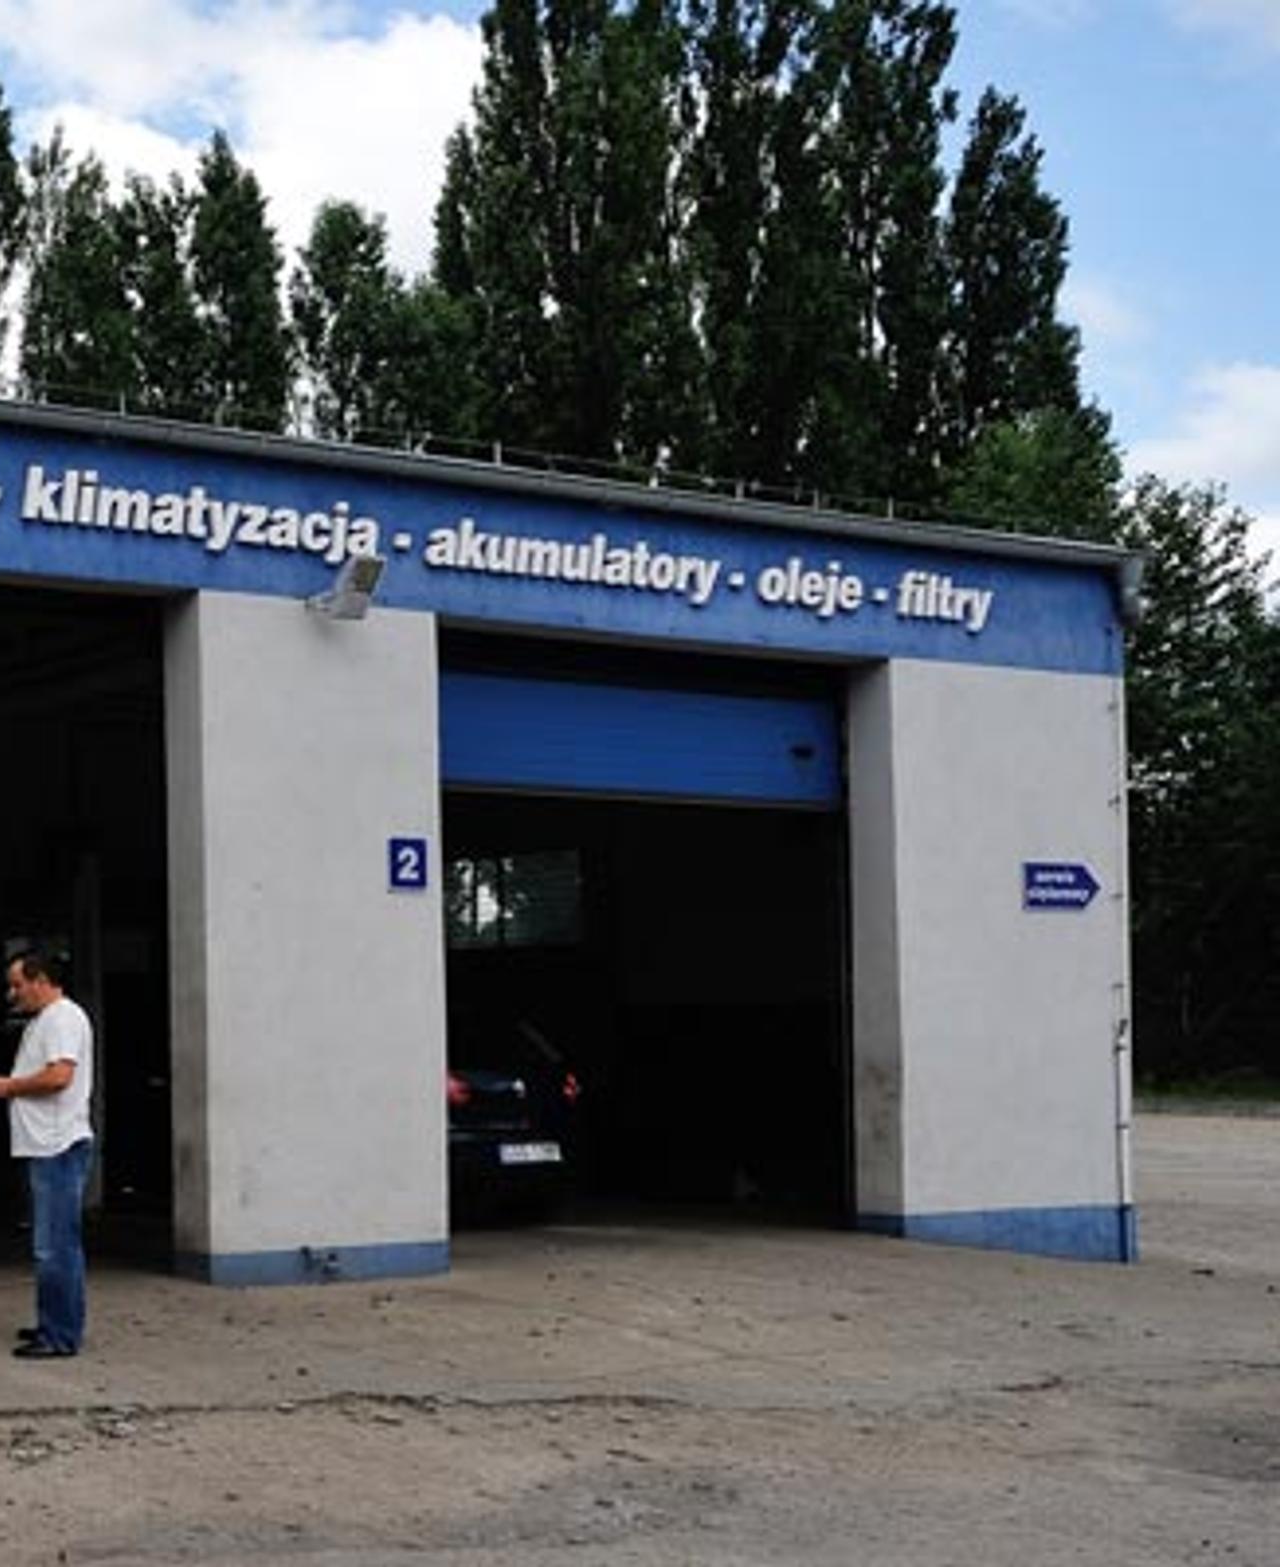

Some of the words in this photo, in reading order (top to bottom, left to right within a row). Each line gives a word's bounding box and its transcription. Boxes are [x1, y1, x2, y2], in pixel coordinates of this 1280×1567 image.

[20, 465, 380, 563] klimatyzacja
[424, 518, 721, 606] akumulatory
[756, 556, 864, 619] oleje
[895, 570, 995, 633] filtry
[397, 846, 420, 881] 2
